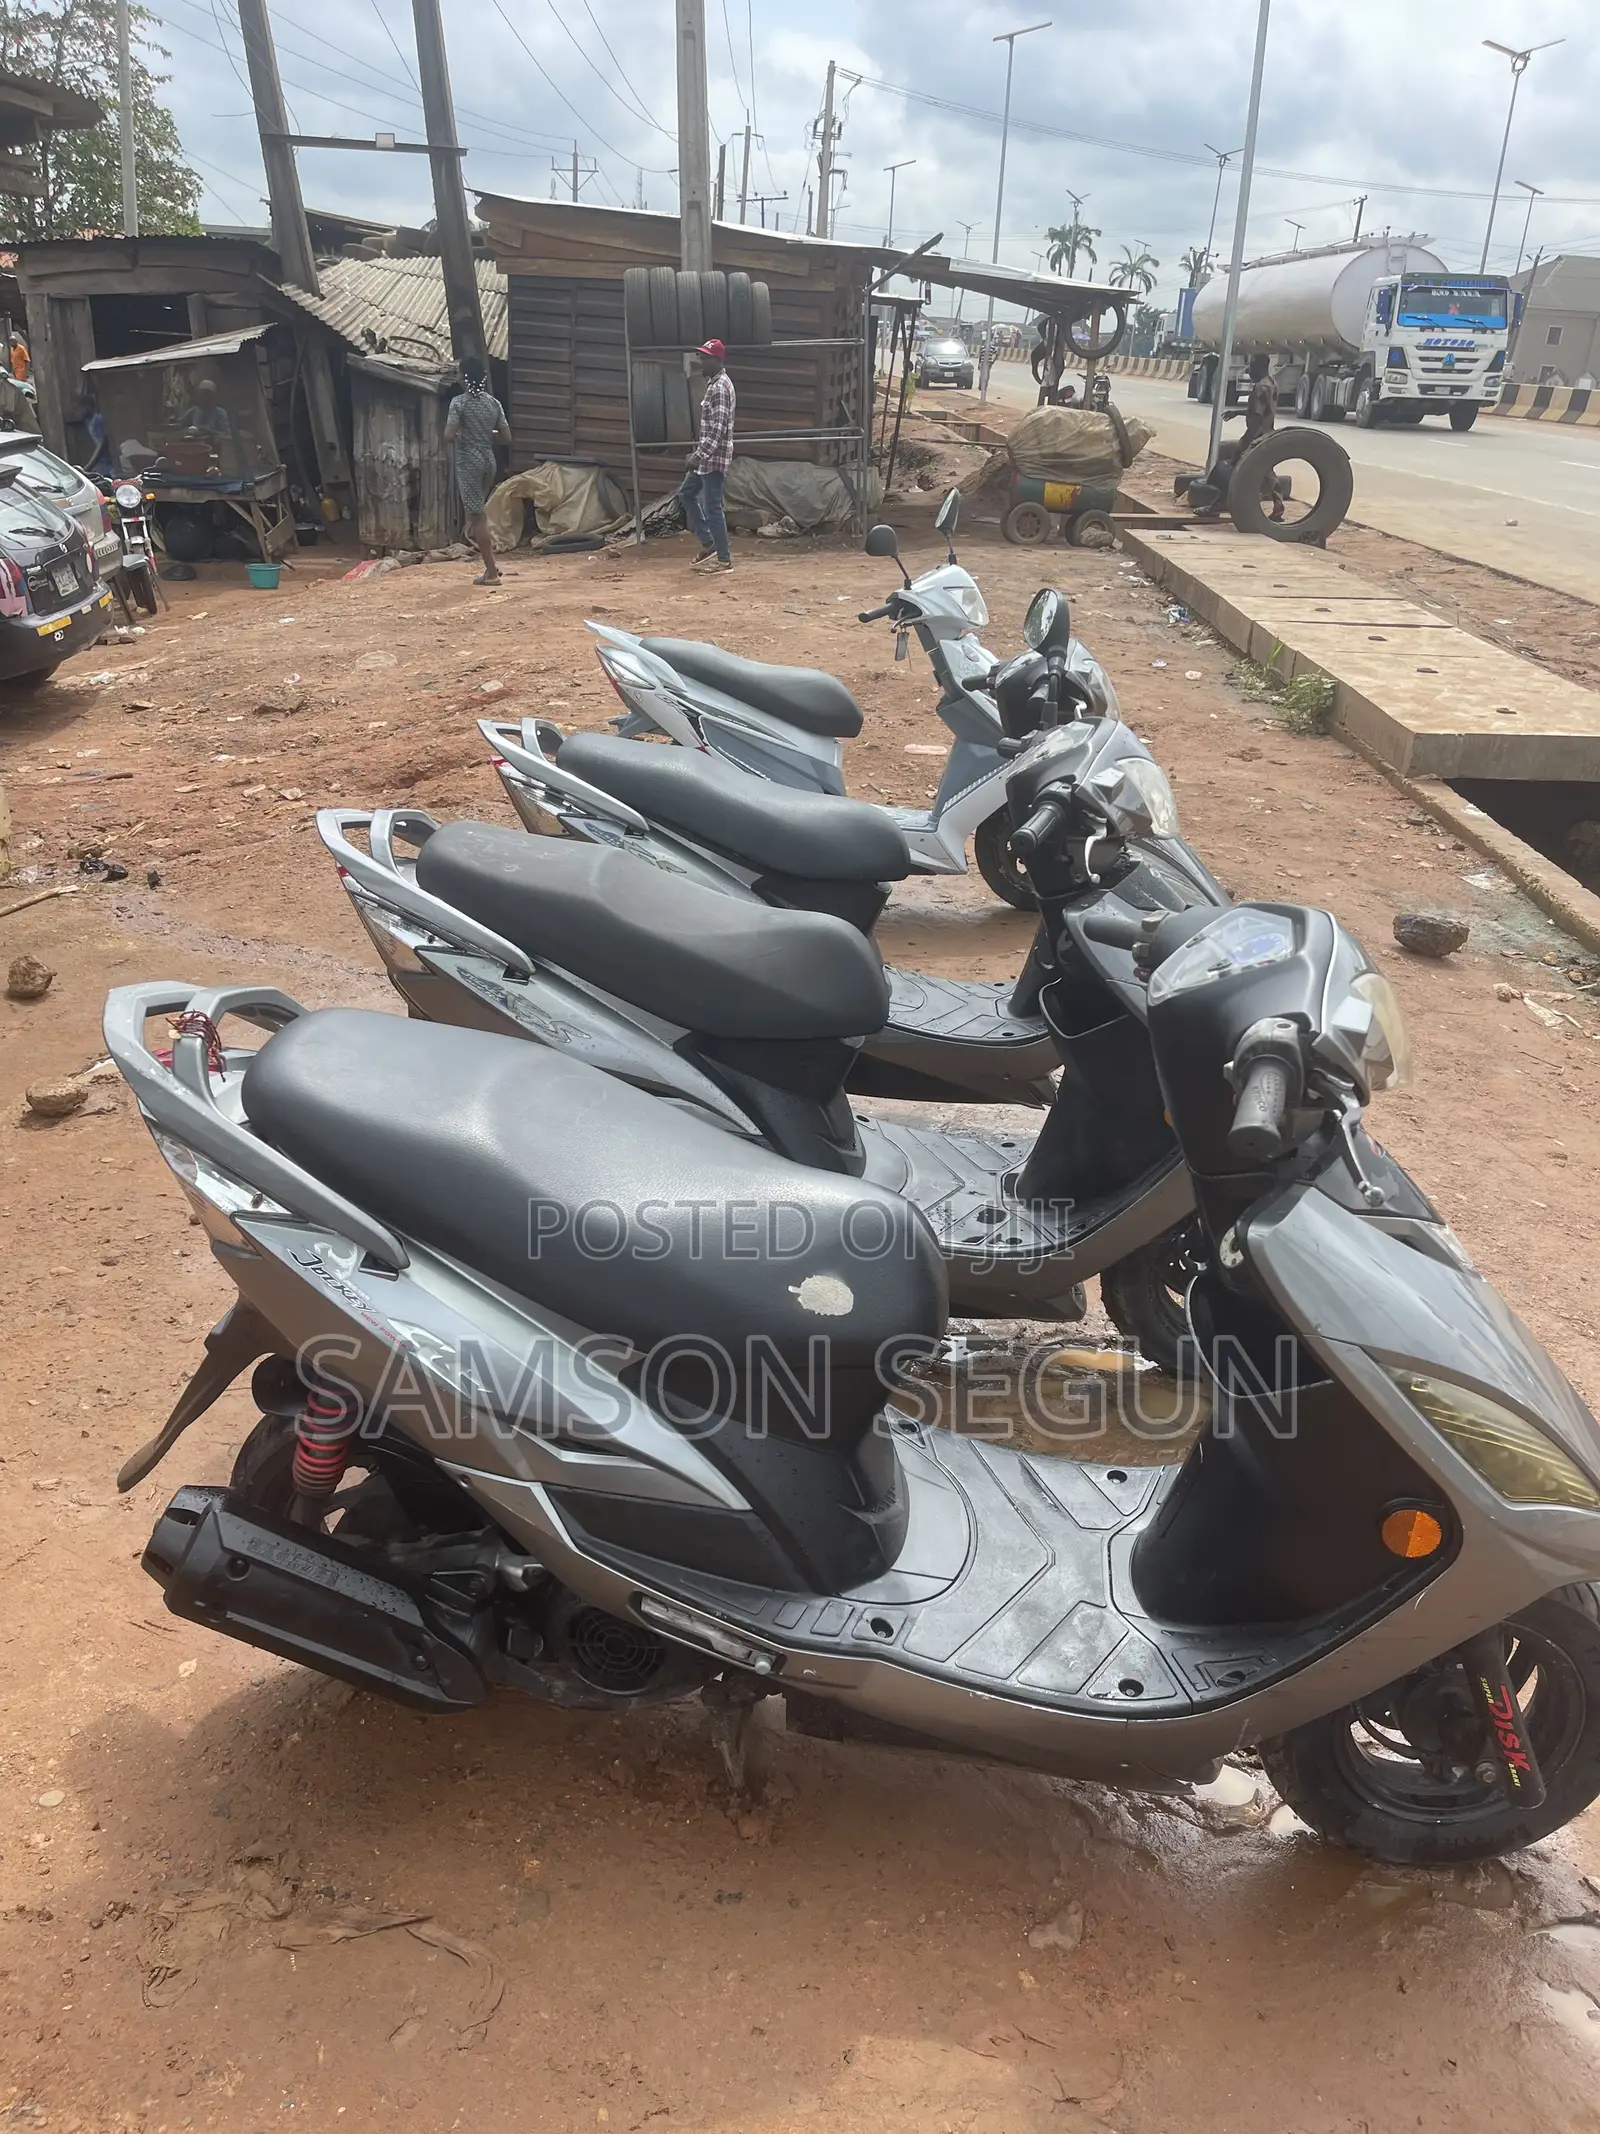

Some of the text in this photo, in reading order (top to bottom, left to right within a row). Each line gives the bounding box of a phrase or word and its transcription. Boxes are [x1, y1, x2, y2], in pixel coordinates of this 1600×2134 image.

[1423, 337, 1476, 347] KOTOKO
[360, 1312, 379, 1327] NEW
[1480, 1676, 1495, 1705] SUPER
[1489, 1683, 1532, 1772] DISK
